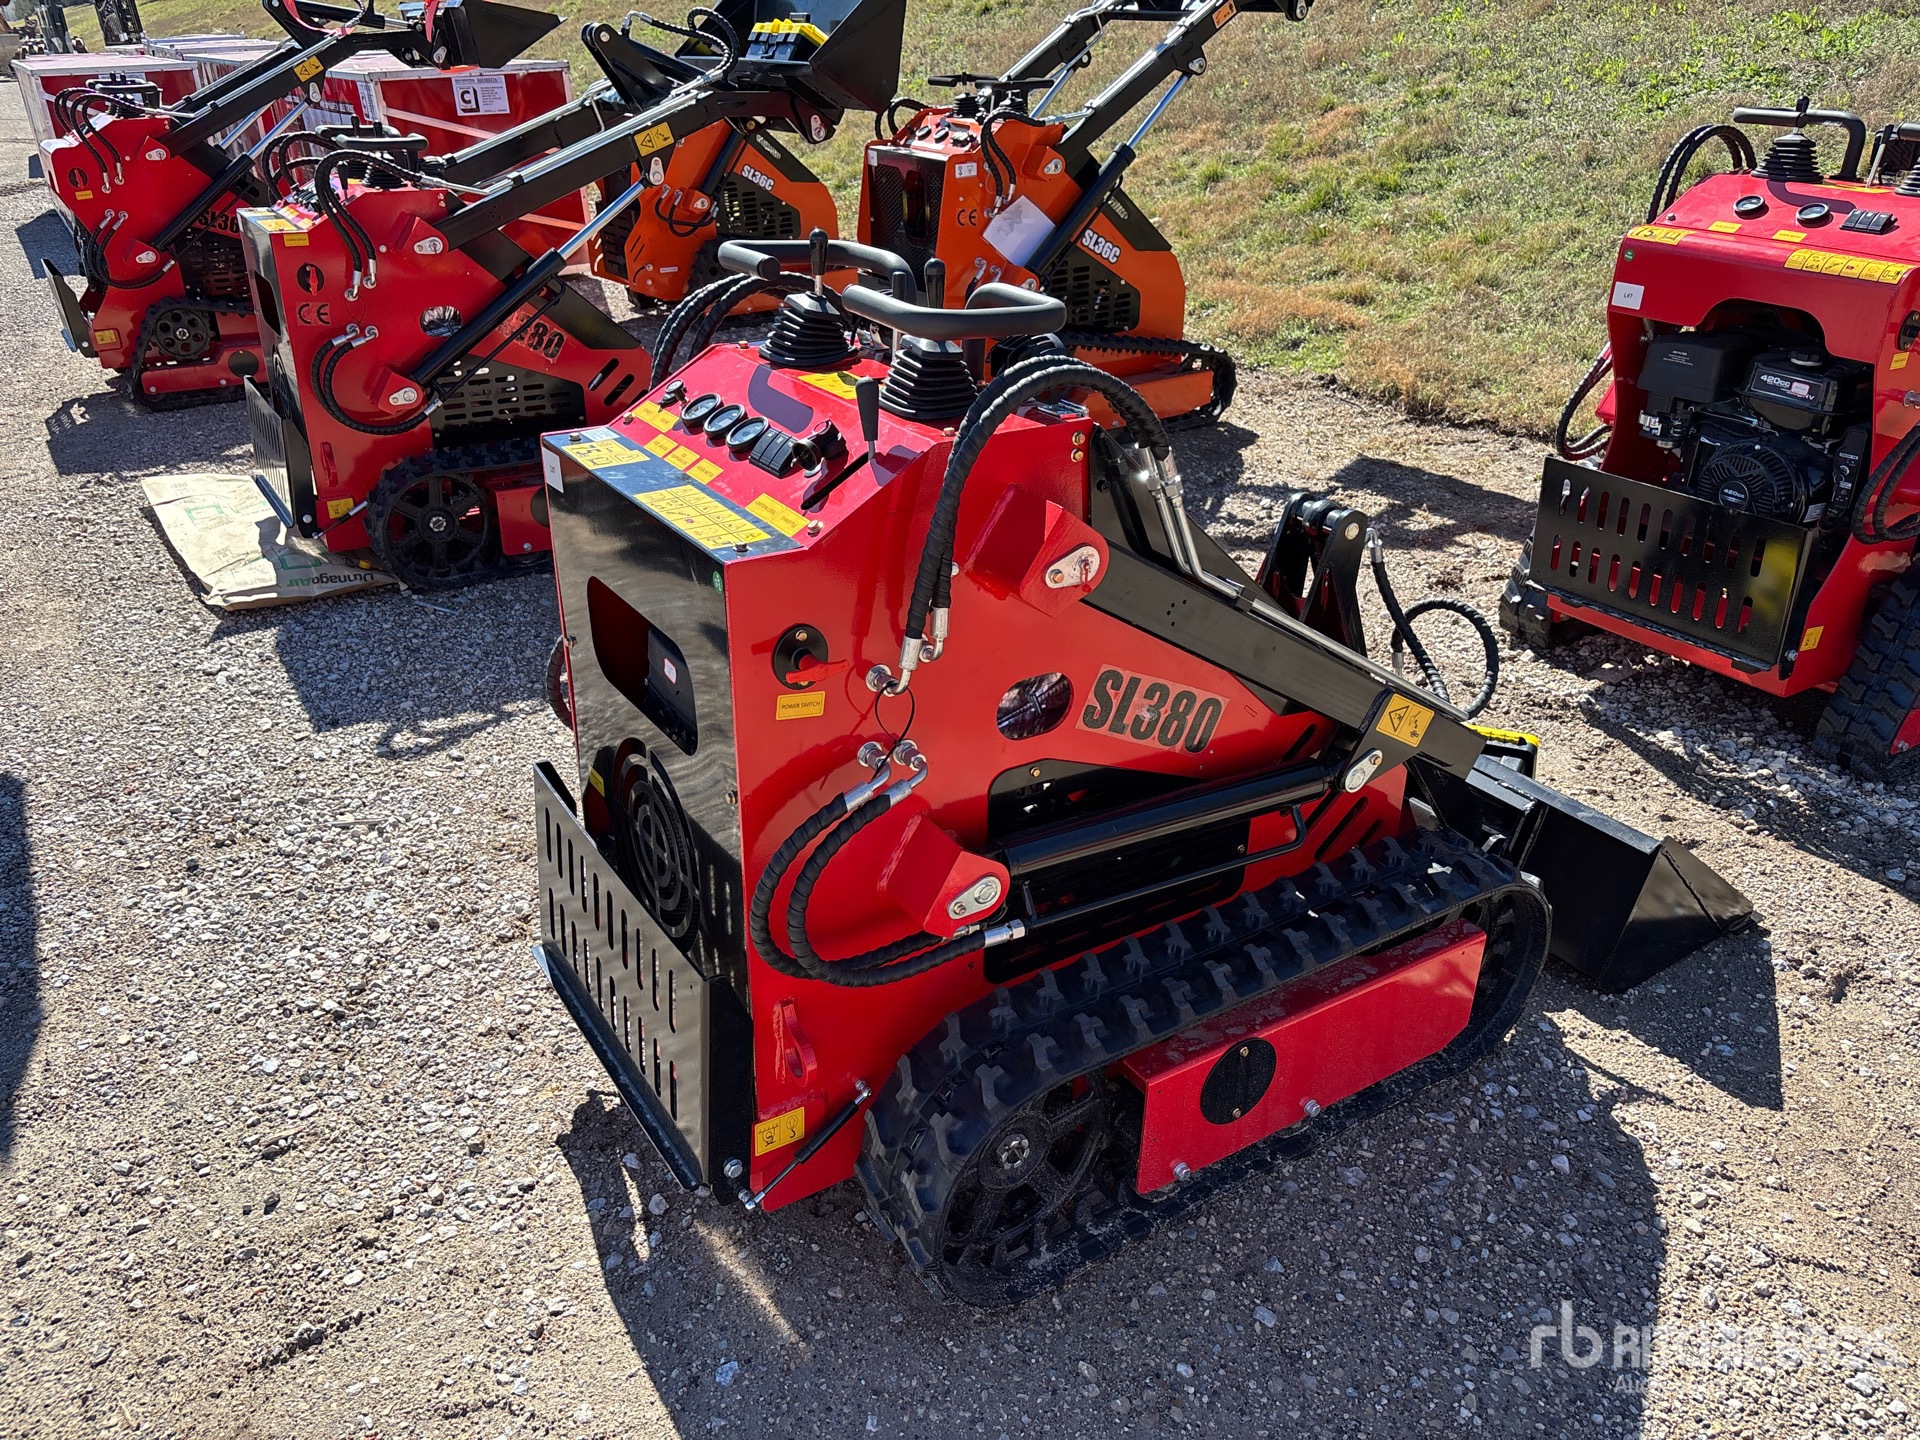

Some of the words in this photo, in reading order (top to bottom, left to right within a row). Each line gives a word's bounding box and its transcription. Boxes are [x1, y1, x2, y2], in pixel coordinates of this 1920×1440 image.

[740, 164, 776, 192] SL36C
[1081, 228, 1121, 264] SL36C
[1760, 374, 1791, 388] 420cc
[1083, 669, 1222, 753] SL380
